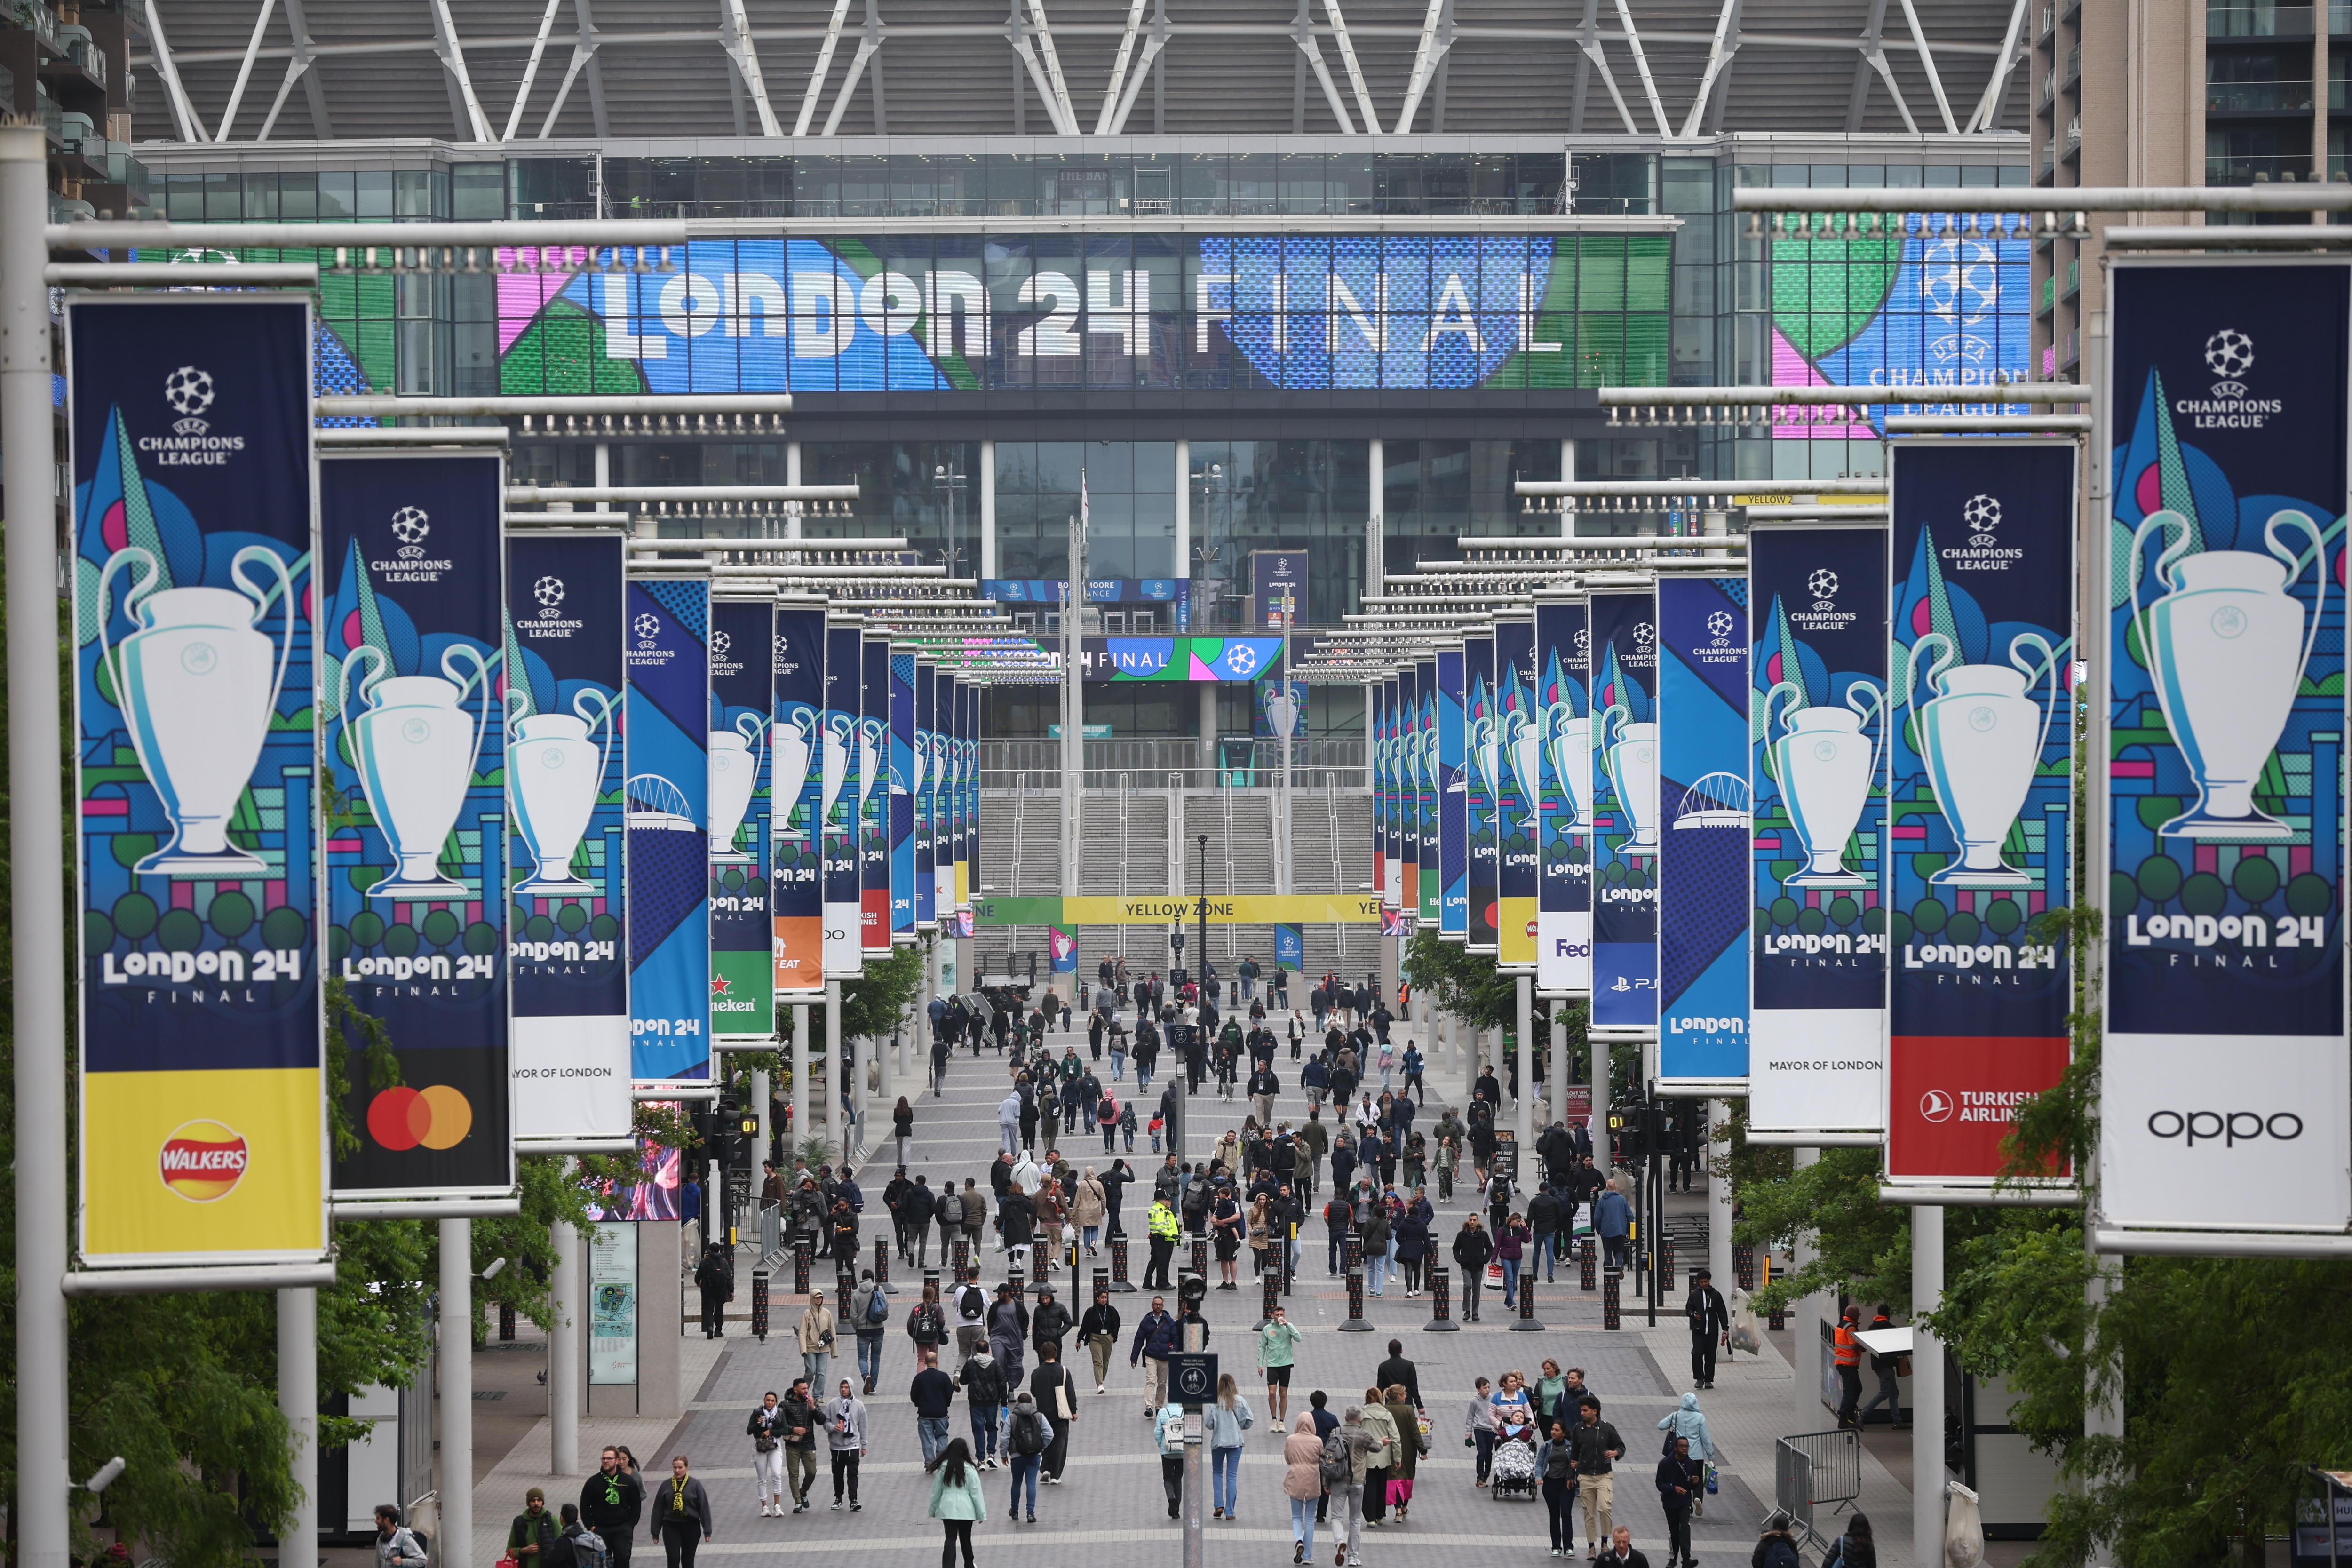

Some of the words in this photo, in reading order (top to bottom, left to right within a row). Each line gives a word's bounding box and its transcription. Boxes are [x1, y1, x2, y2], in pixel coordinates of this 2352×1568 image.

[1017, 270, 1149, 356] 24
[1196, 272, 1563, 353] FINAL
[1934, 341, 1985, 360] UEFA
[1869, 368, 2029, 386] CHAMPION
[2212, 383, 2247, 398] UEFA
[2176, 399, 2282, 414] CHAMPIONS
[2195, 415, 2264, 428] LEAGUE
[174, 421, 209, 435] UEFA
[139, 436, 244, 451] CHAMPIONS
[158, 452, 227, 465] LEAGUE
[1748, 495, 1786, 504] YELLOW
[1969, 535, 1995, 547] UEFA
[397, 547, 425, 558] UEFA
[1942, 549, 2023, 559] CHAMPIONS
[371, 559, 452, 571] CHAMPIONS
[1956, 560, 2009, 570] LEAGUE
[385, 571, 438, 582] LEAGUE
[1813, 603, 1834, 611] UEFA
[539, 609, 560, 618] UEFA
[1791, 612, 1856, 621] CHAMPIONS
[517, 619, 583, 628] CHAMPIONS
[529, 629, 571, 637] LEAGUE
[1099, 652, 1167, 667] FINAL
[917, 840, 930, 849] 24
[868, 851, 883, 861] 24
[835, 860, 853, 871] 24
[796, 869, 815, 882] 24
[742, 897, 764, 911] 24
[895, 899, 909, 909] 24
[1127, 904, 1187, 916] YELLOW
[976, 905, 994, 917] NE
[2275, 915, 2324, 947] 24
[1556, 938, 1590, 957] Fed
[1856, 934, 1886, 954] 24
[584, 941, 615, 961] 24
[252, 949, 301, 981] 24
[456, 955, 493, 979] 24
[779, 959, 800, 969] EAT
[1791, 958, 1858, 967] FINAL
[2170, 954, 2278, 968] FINAL
[520, 966, 587, 974] FINAL
[1938, 974, 2020, 985] FINAL
[148, 990, 255, 1003] FINAL
[376, 987, 459, 996] FINAL
[674, 1019, 699, 1035] 24
[1769, 1061, 1810, 1071] MAYOR
[1812, 1061, 1829, 1070] OF
[1831, 1060, 1883, 1070] LONDON
[512, 1068, 538, 1079] YOR
[540, 1068, 557, 1078] OF
[560, 1068, 612, 1078] LONDON
[2148, 1111, 2303, 1148] oppo
[161, 1146, 246, 1170] WALKERS
